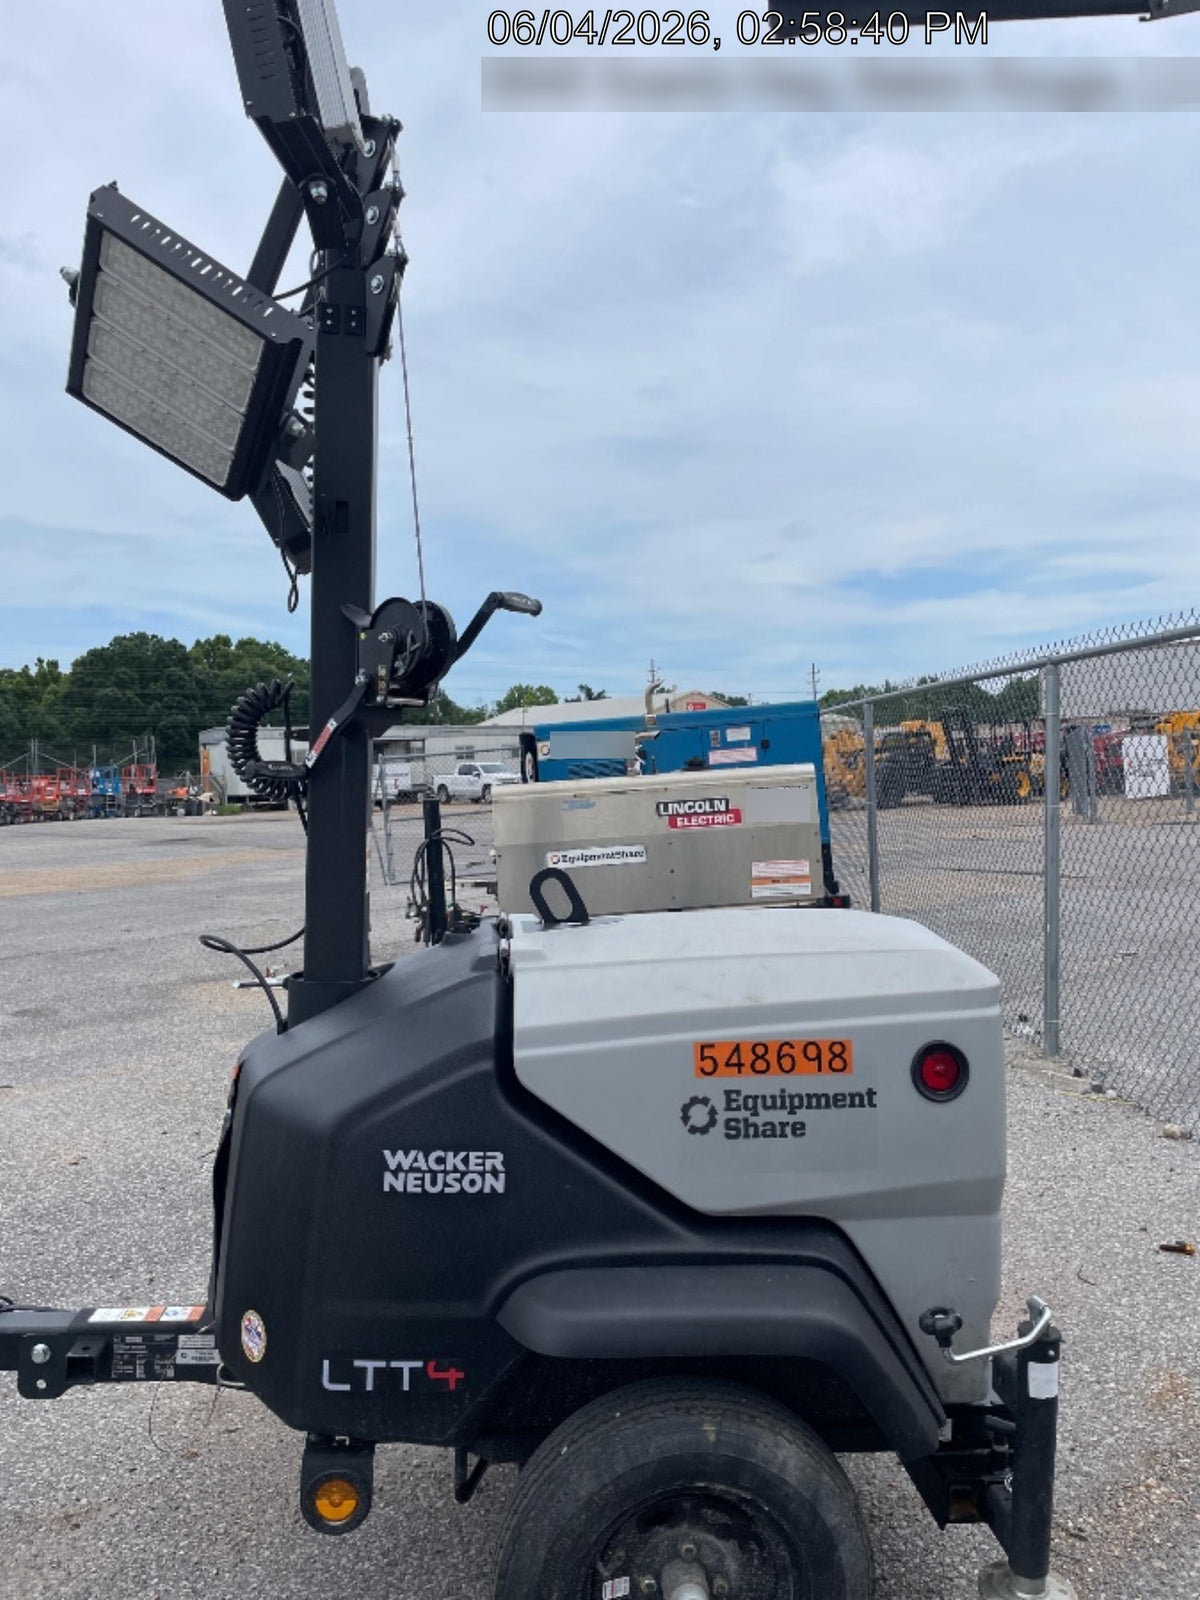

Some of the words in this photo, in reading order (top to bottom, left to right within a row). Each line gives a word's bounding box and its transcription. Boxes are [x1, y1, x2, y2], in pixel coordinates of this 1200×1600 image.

[660, 799, 726, 815] LINCOLN
[676, 813, 735, 827] ELECTRIC
[699, 1041, 848, 1076] 548698
[722, 1087, 877, 1116] Equipment
[723, 1117, 806, 1140] Share
[383, 1150, 506, 1172] WACKER
[383, 1171, 506, 1194] NEUSON
[322, 1359, 465, 1391] LTT4
